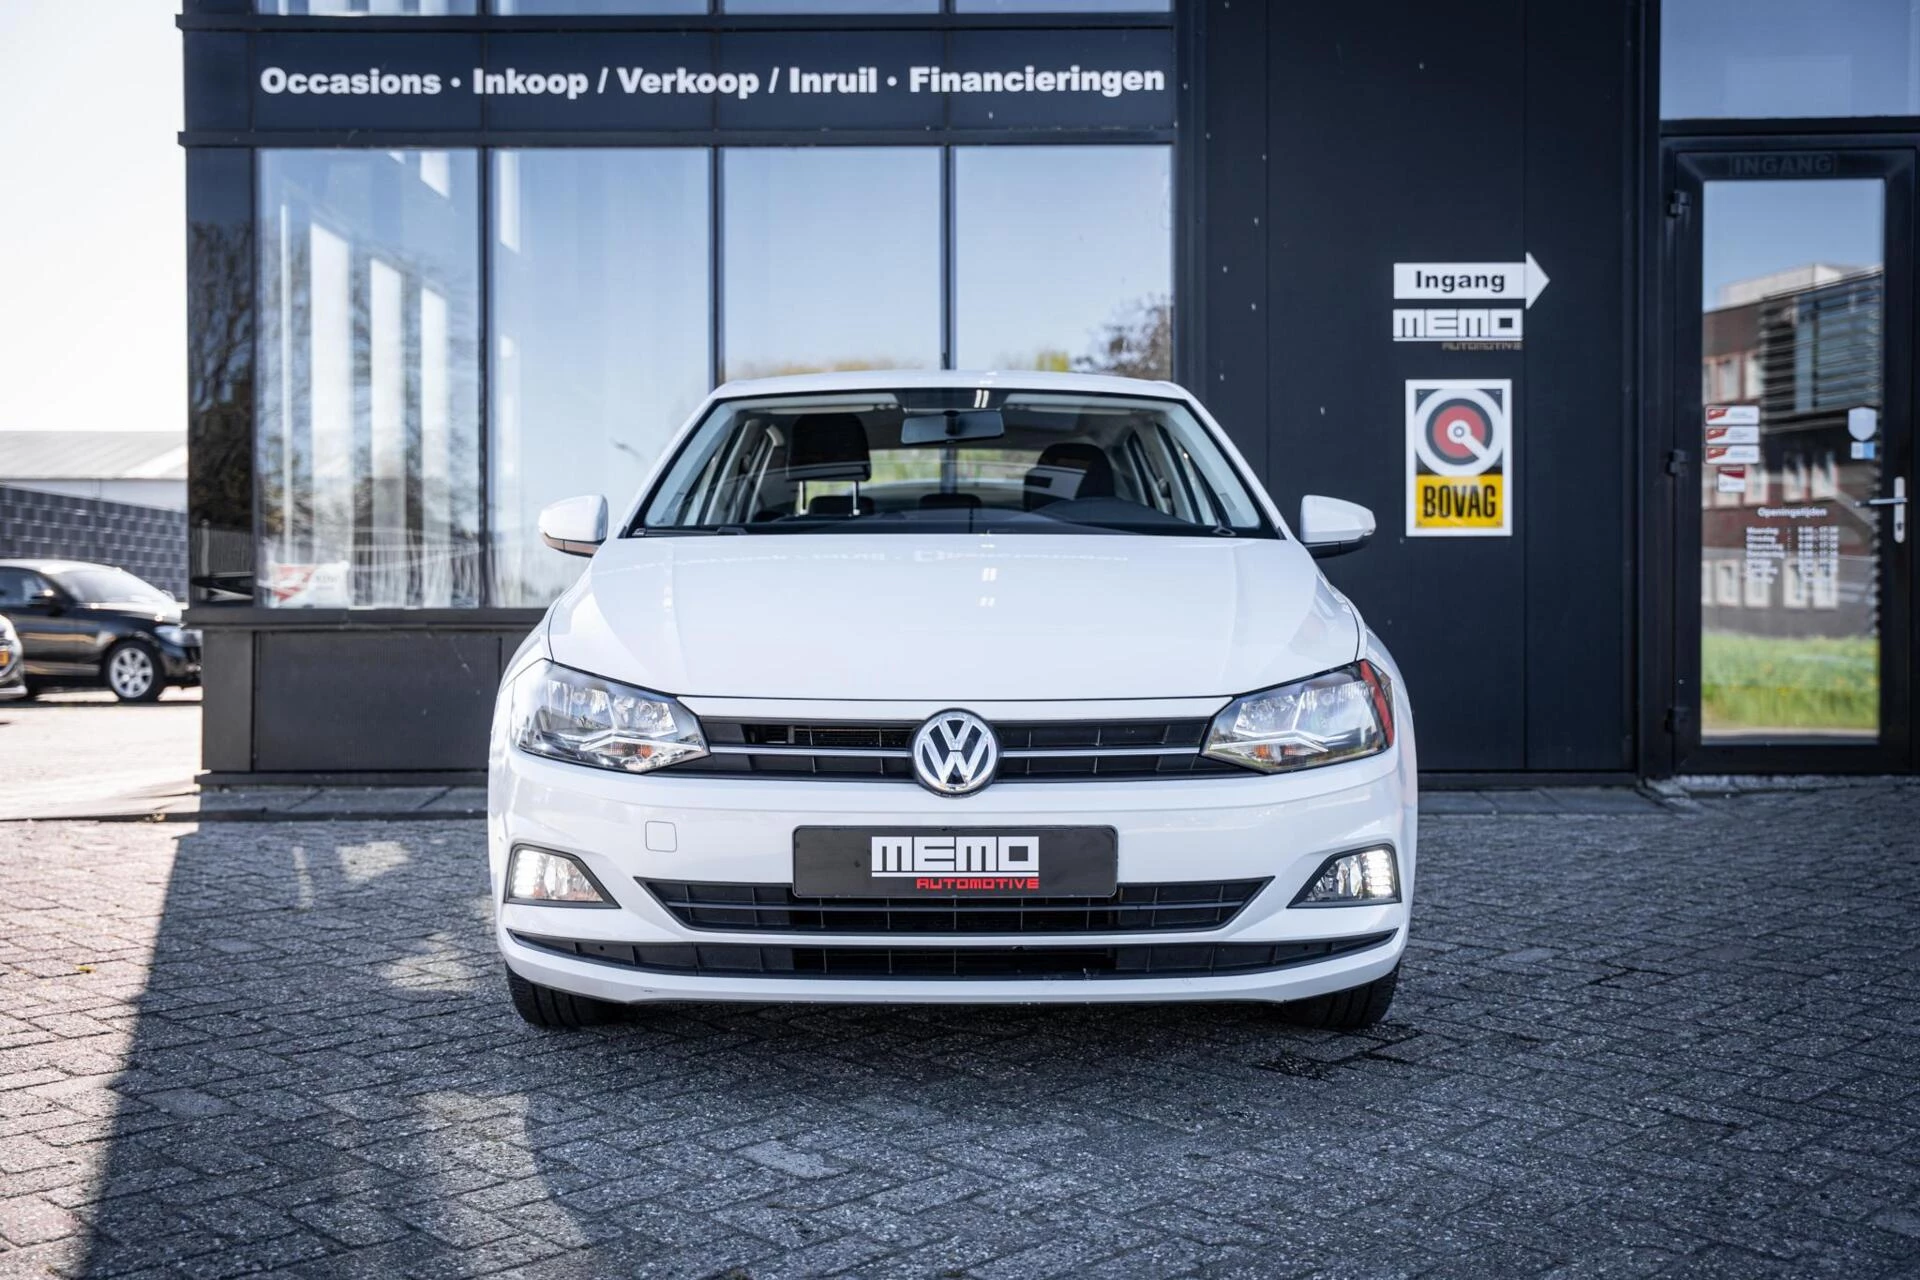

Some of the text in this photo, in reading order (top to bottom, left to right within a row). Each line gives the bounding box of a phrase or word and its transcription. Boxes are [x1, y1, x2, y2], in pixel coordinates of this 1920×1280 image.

[260, 67, 442, 95] Occasions
[473, 67, 589, 100] Inkoop
[616, 67, 760, 100] Verkoop
[789, 66, 878, 94] Inruil
[909, 65, 1165, 98] Financieringen
[1734, 155, 1832, 174] INGANG
[1416, 270, 1506, 293] Ingang
[1393, 309, 1523, 337] MEMO
[1442, 341, 1522, 351] AUTOMOTIVE
[1423, 484, 1496, 518] BOVAG
[1757, 507, 1827, 518] Openingstijden
[871, 836, 1040, 871] MEMO
[915, 877, 1040, 890] AUTOMOTIVE
